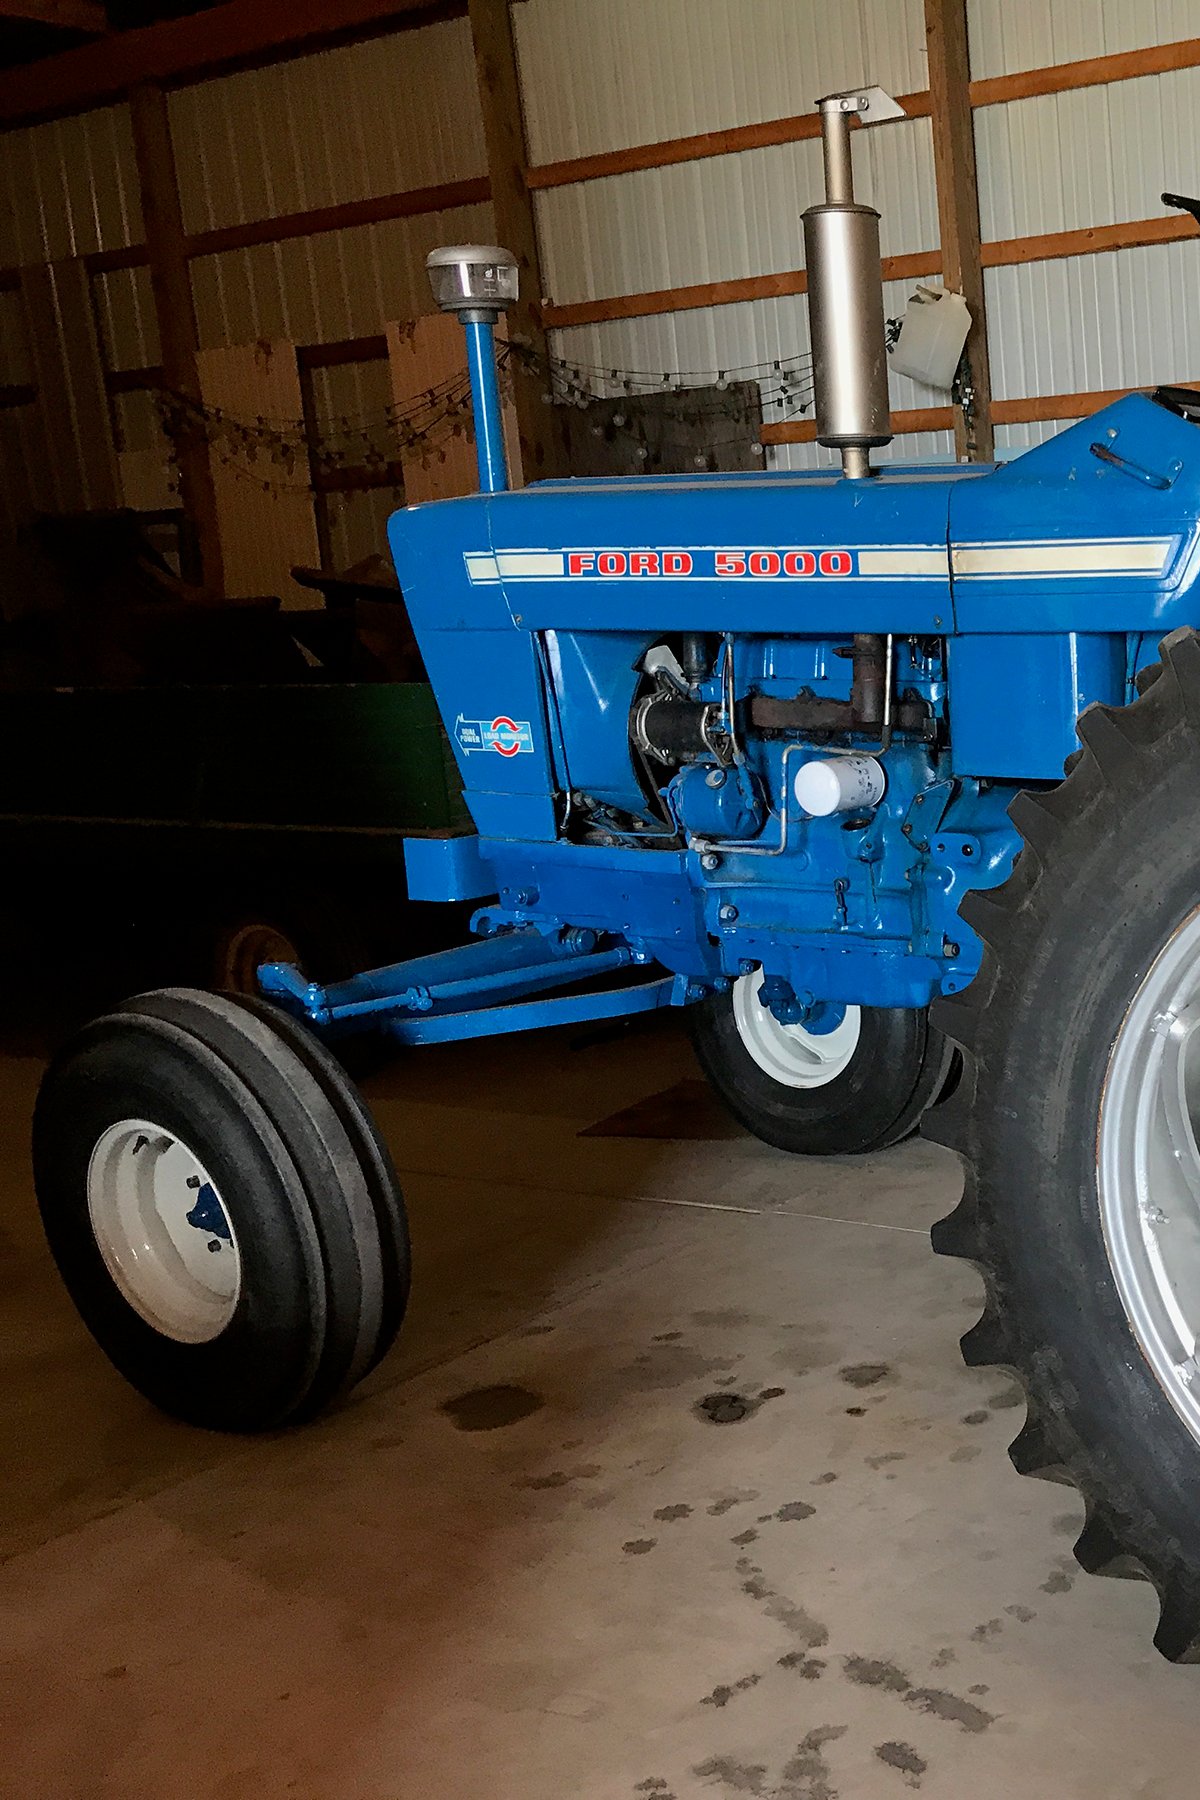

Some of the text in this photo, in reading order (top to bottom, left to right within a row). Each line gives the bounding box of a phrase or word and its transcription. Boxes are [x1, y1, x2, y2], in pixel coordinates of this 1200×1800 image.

[568, 550, 853, 577] FORD 5000
[460, 735, 480, 743] POWER
